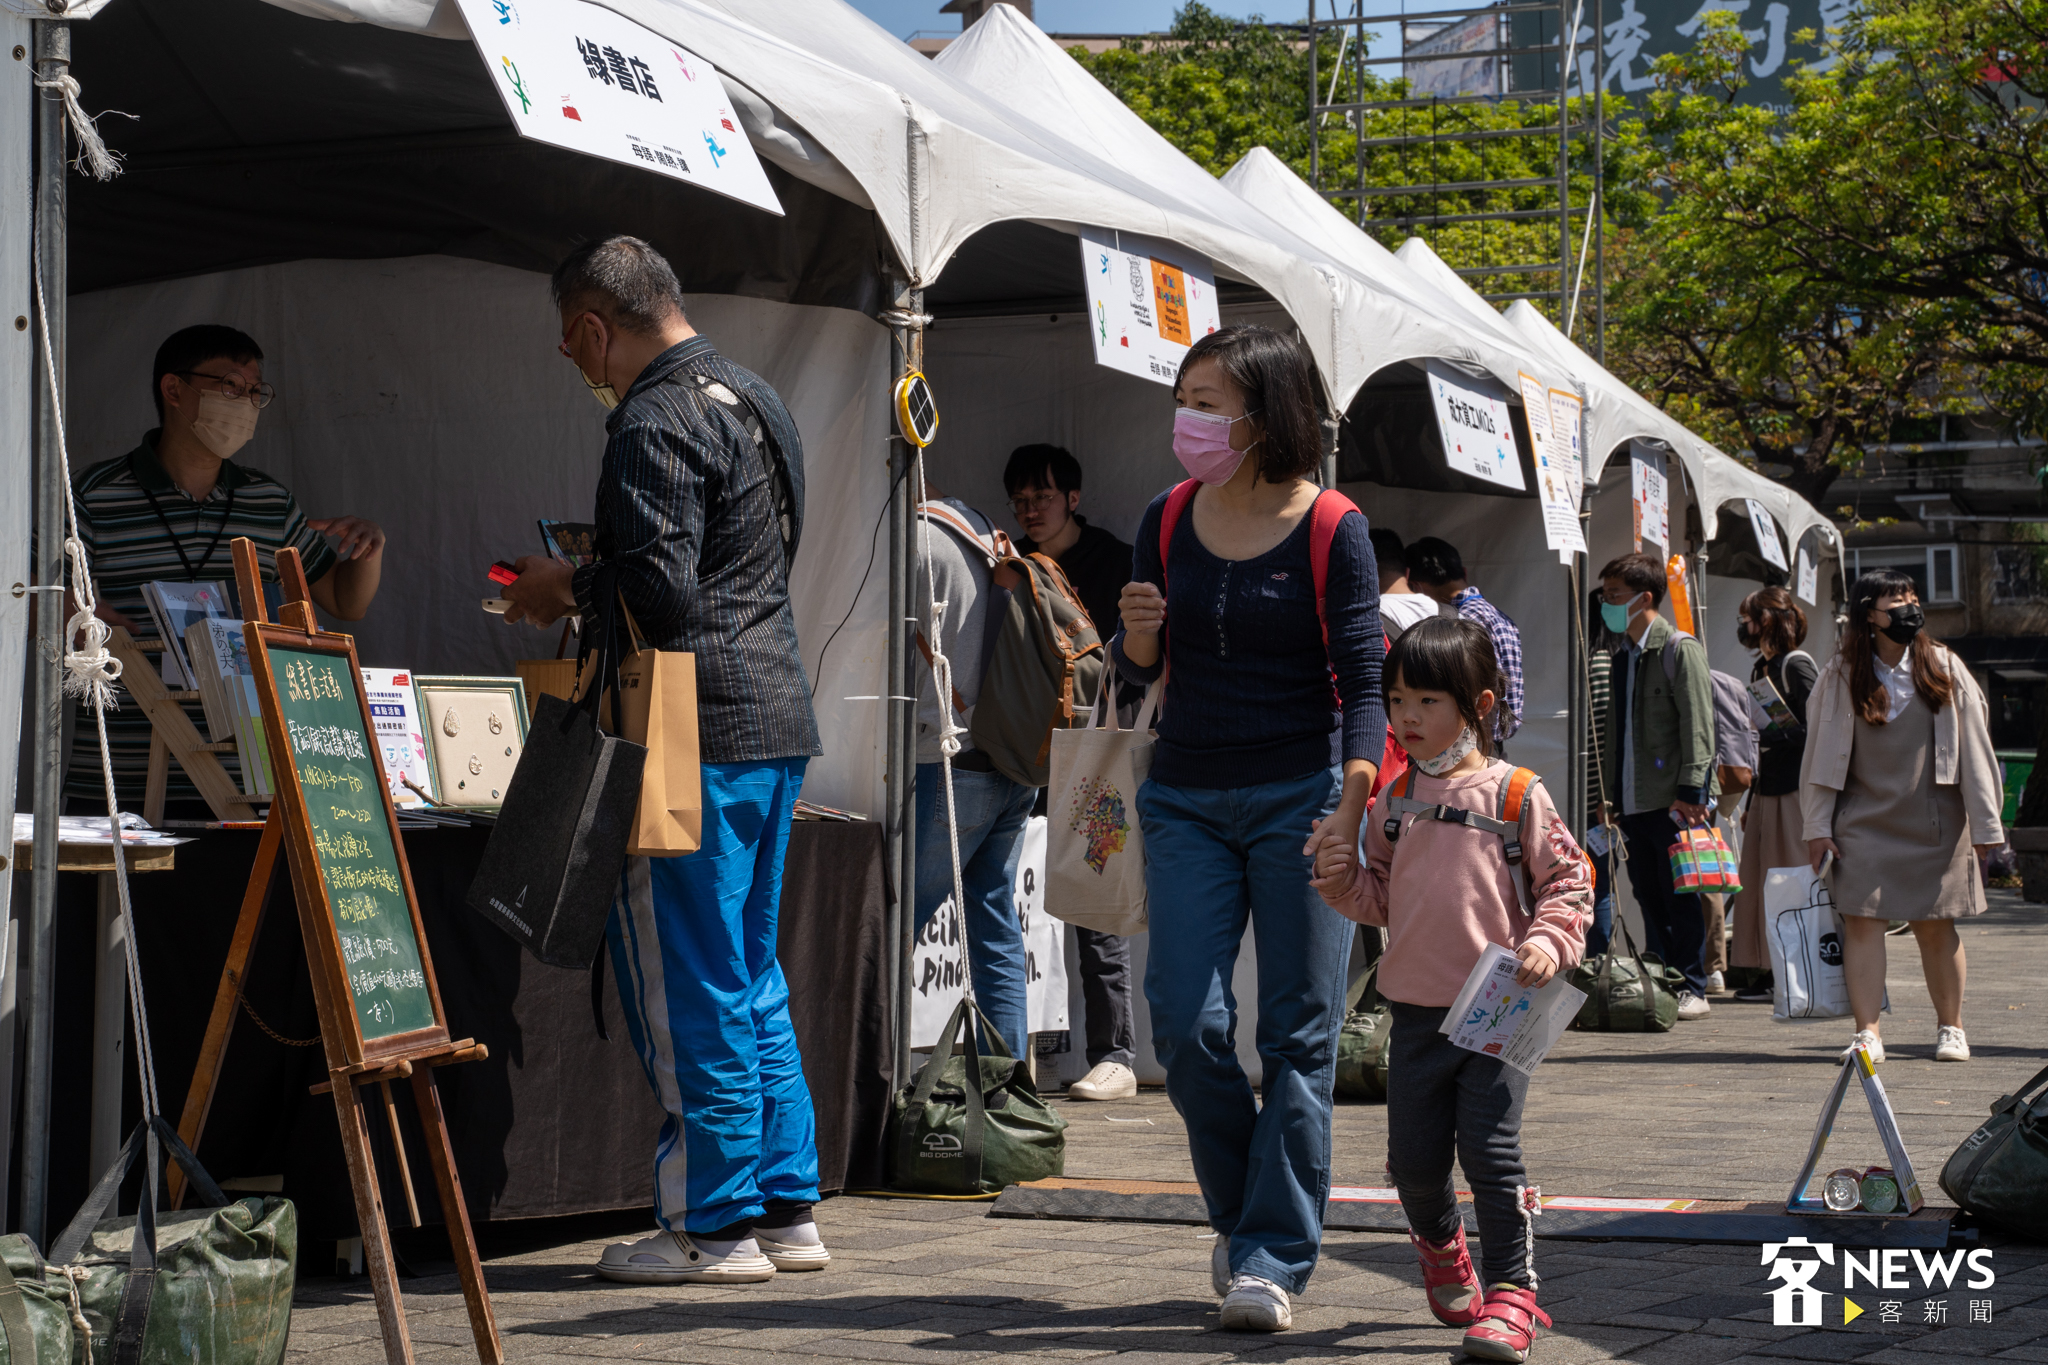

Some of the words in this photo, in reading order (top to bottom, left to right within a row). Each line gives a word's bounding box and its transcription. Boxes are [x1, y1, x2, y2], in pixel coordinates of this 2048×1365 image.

[212, 622, 234, 669] 弟の夫
[935, 1151, 963, 1159] DOME
